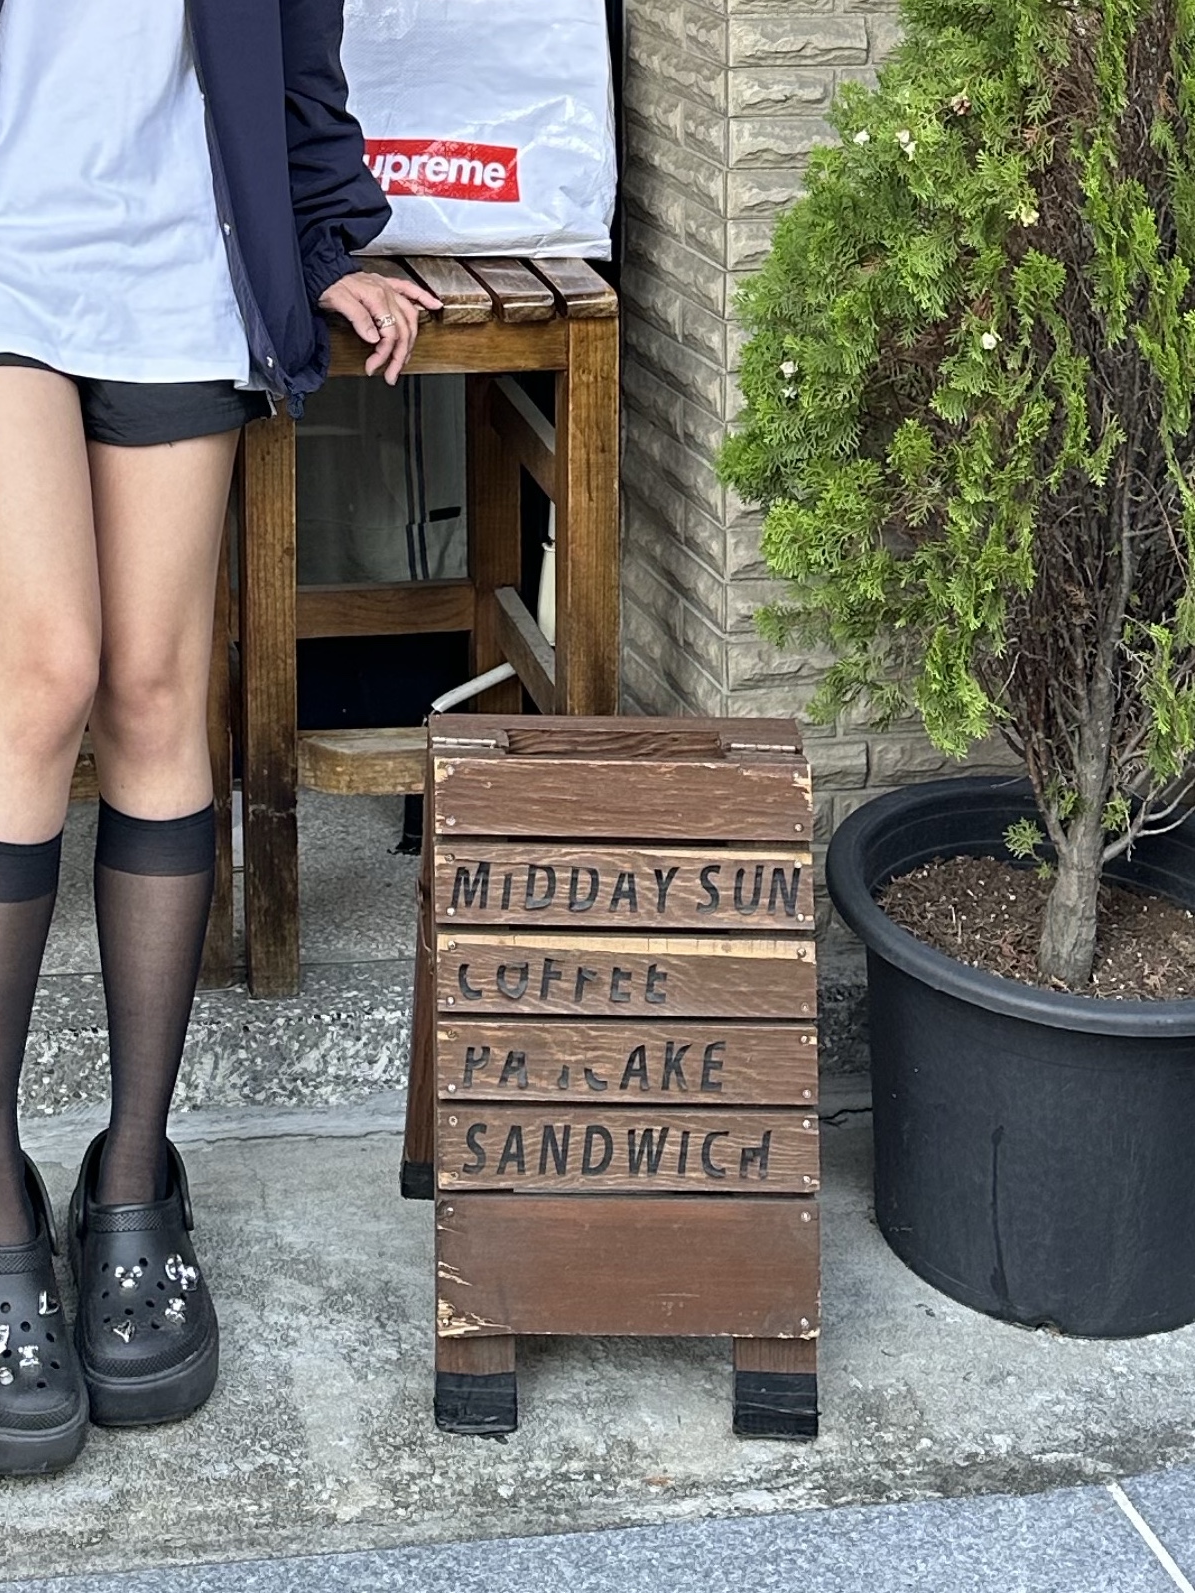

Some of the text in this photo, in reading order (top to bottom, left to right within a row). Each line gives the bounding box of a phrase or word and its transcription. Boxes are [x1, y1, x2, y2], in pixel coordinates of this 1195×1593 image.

[363, 153, 507, 192] upreme
[451, 861, 802, 916] MIDDAY SUN
[463, 1040, 727, 1092] PAAKE
[462, 1122, 773, 1180] SANDWICH
